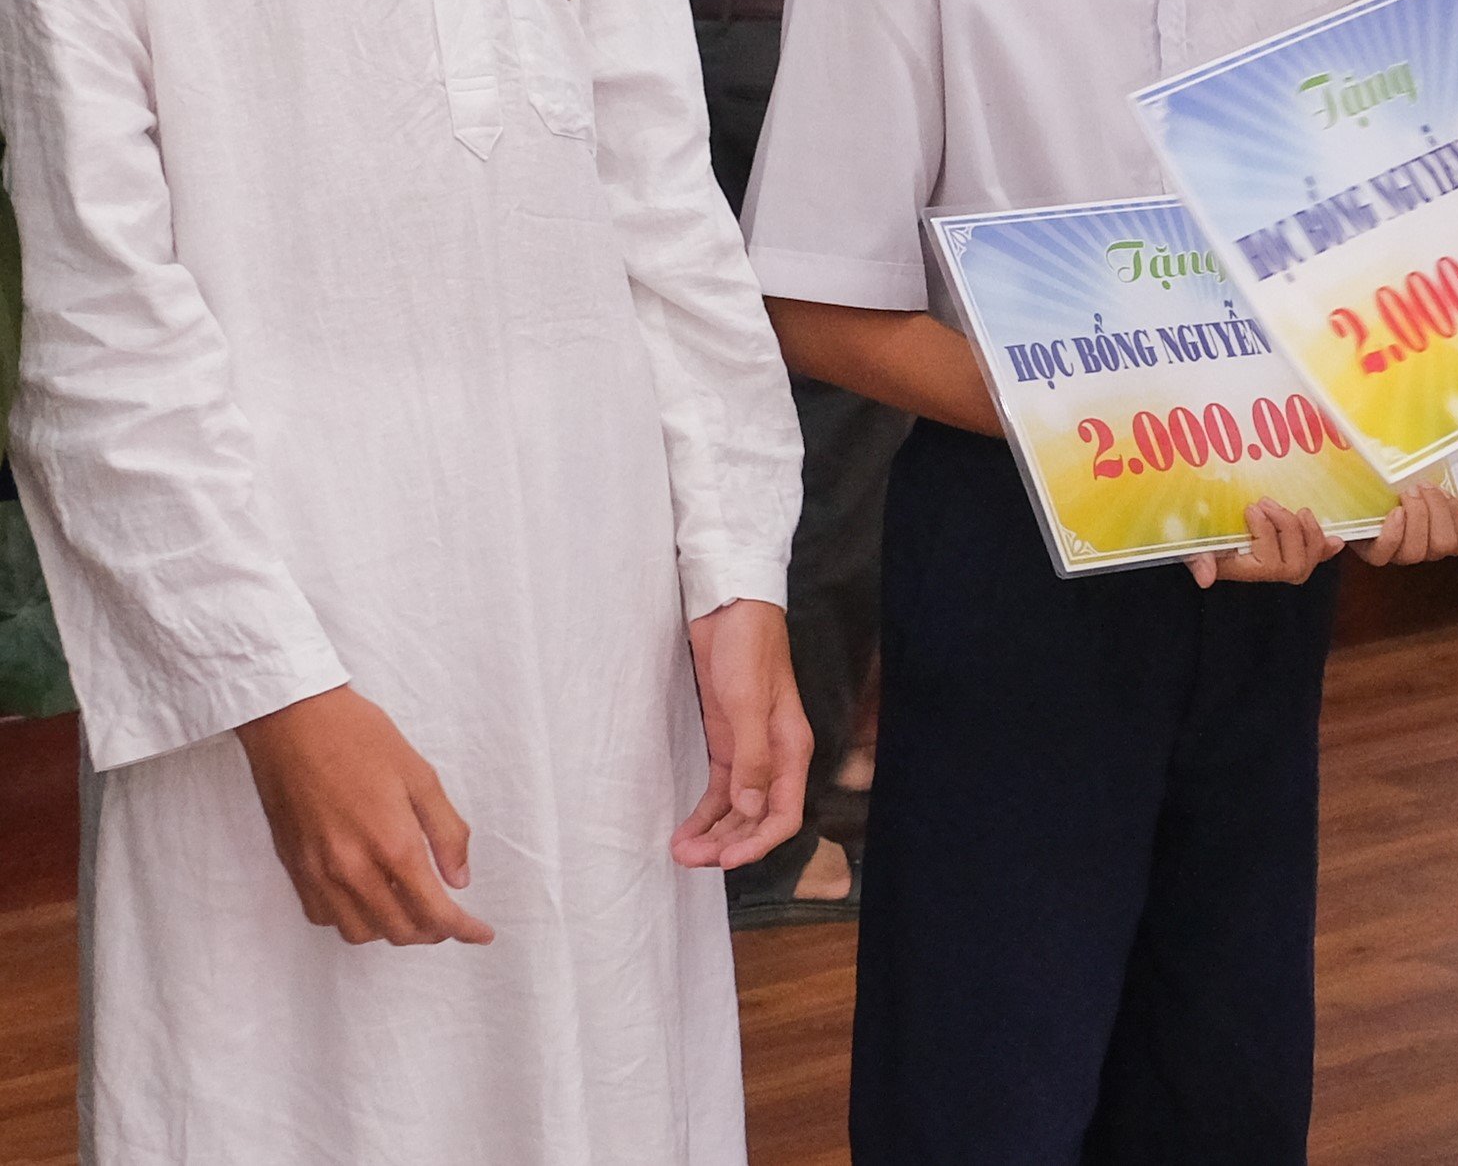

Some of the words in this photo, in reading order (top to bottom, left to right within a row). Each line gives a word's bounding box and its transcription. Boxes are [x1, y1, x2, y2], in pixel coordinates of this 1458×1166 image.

[1298, 62, 1418, 131] Tặng
[1005, 339, 1074, 390] HỌC
[1071, 312, 1159, 374] BỔNG
[1155, 299, 1273, 364] NGUYỄN
